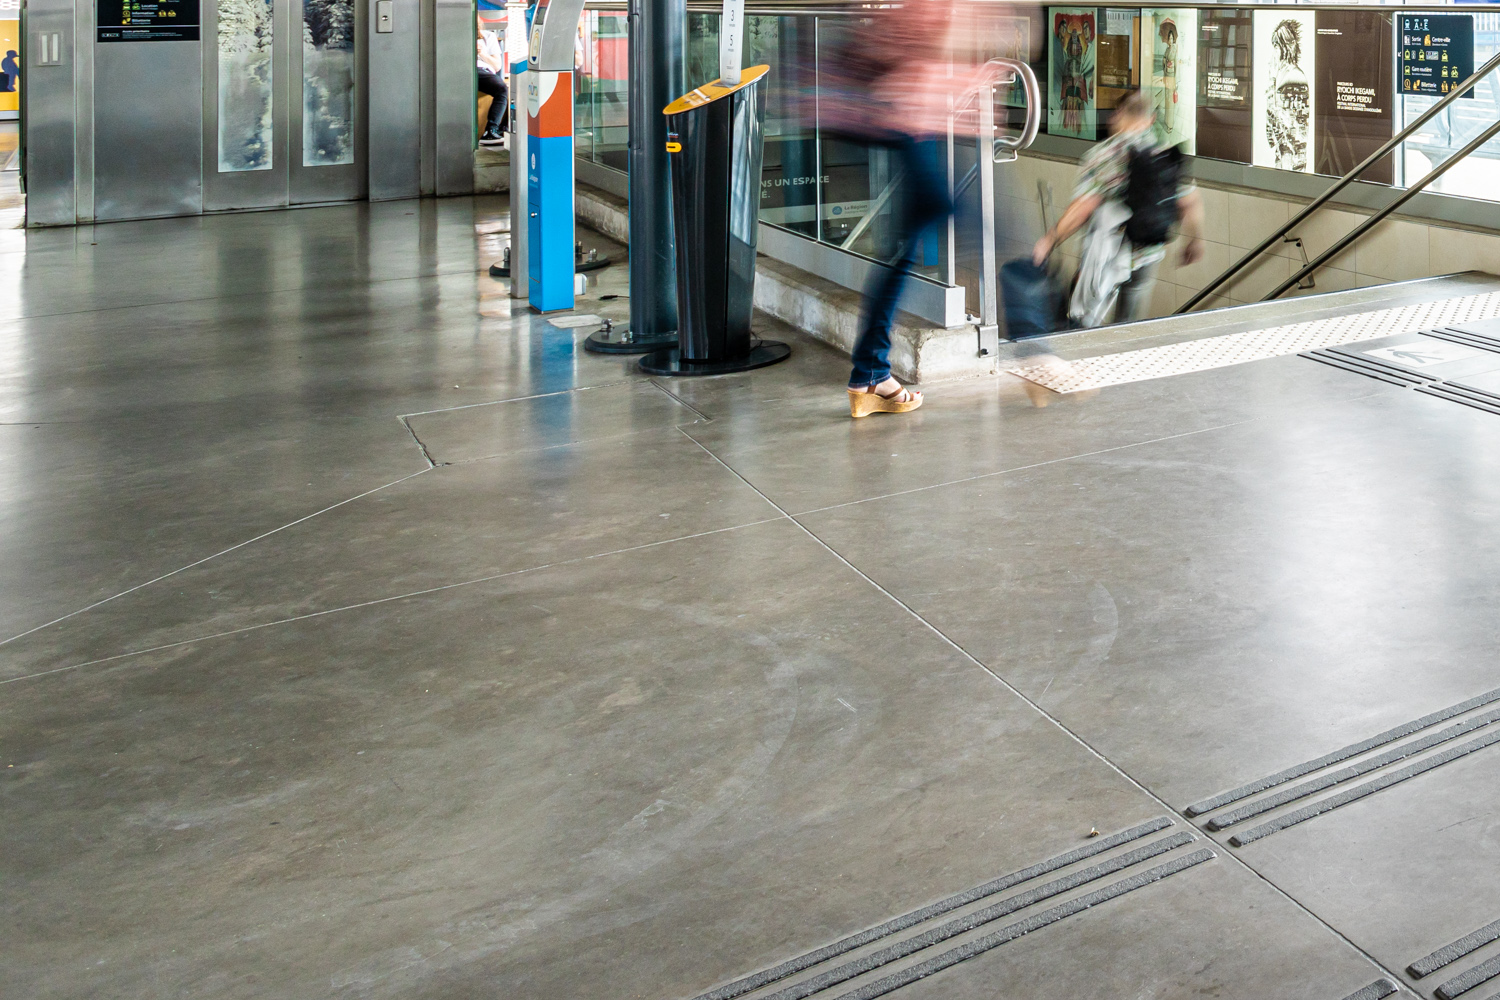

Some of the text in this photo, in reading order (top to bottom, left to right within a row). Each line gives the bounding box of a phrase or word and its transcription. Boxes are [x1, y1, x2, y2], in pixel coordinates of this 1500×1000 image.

[1337, 86, 1375, 96] RYOICHI IKEGAMI,
[1356, 95, 1372, 104] PERDU
[774, 178, 790, 187] UN
[792, 176, 830, 186] ESPACE
